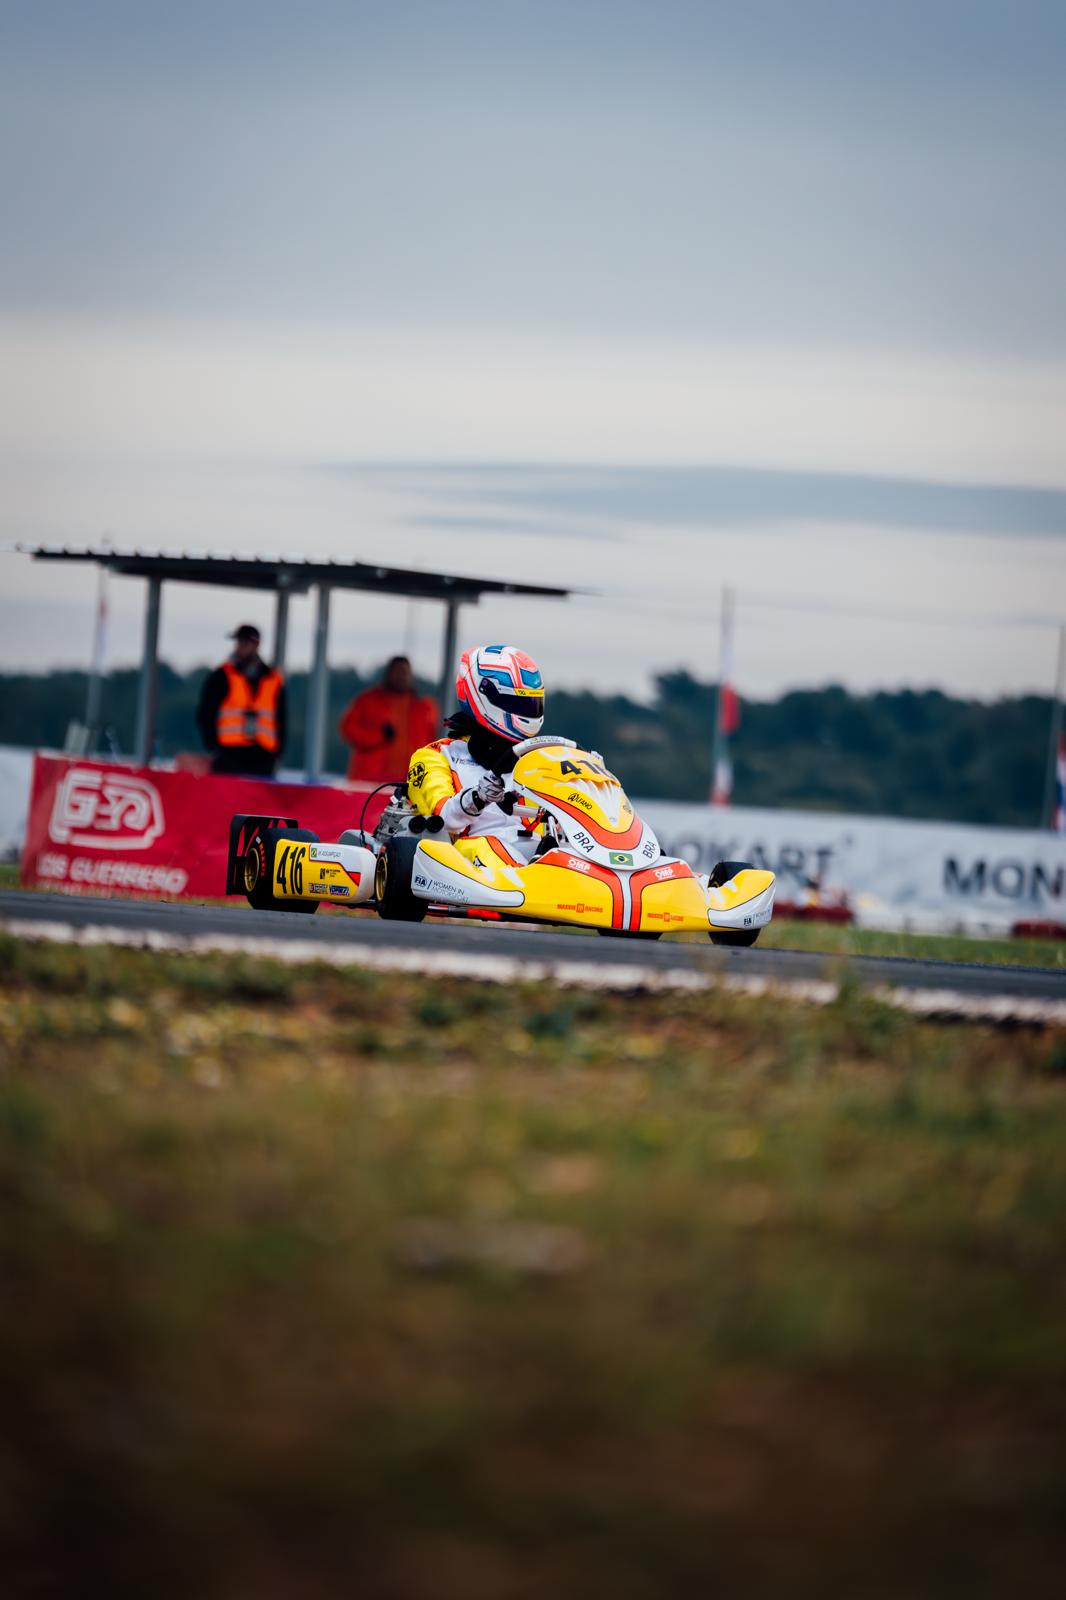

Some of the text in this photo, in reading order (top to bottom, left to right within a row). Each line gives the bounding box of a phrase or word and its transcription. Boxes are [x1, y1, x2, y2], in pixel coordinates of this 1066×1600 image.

[573, 831, 595, 853] BRA
[642, 840, 657, 859] BRA
[276, 845, 306, 895] 416
[568, 859, 591, 871] OMP
[654, 867, 675, 878] OMP
[414, 875, 465, 896] FIA WOMEN IN
